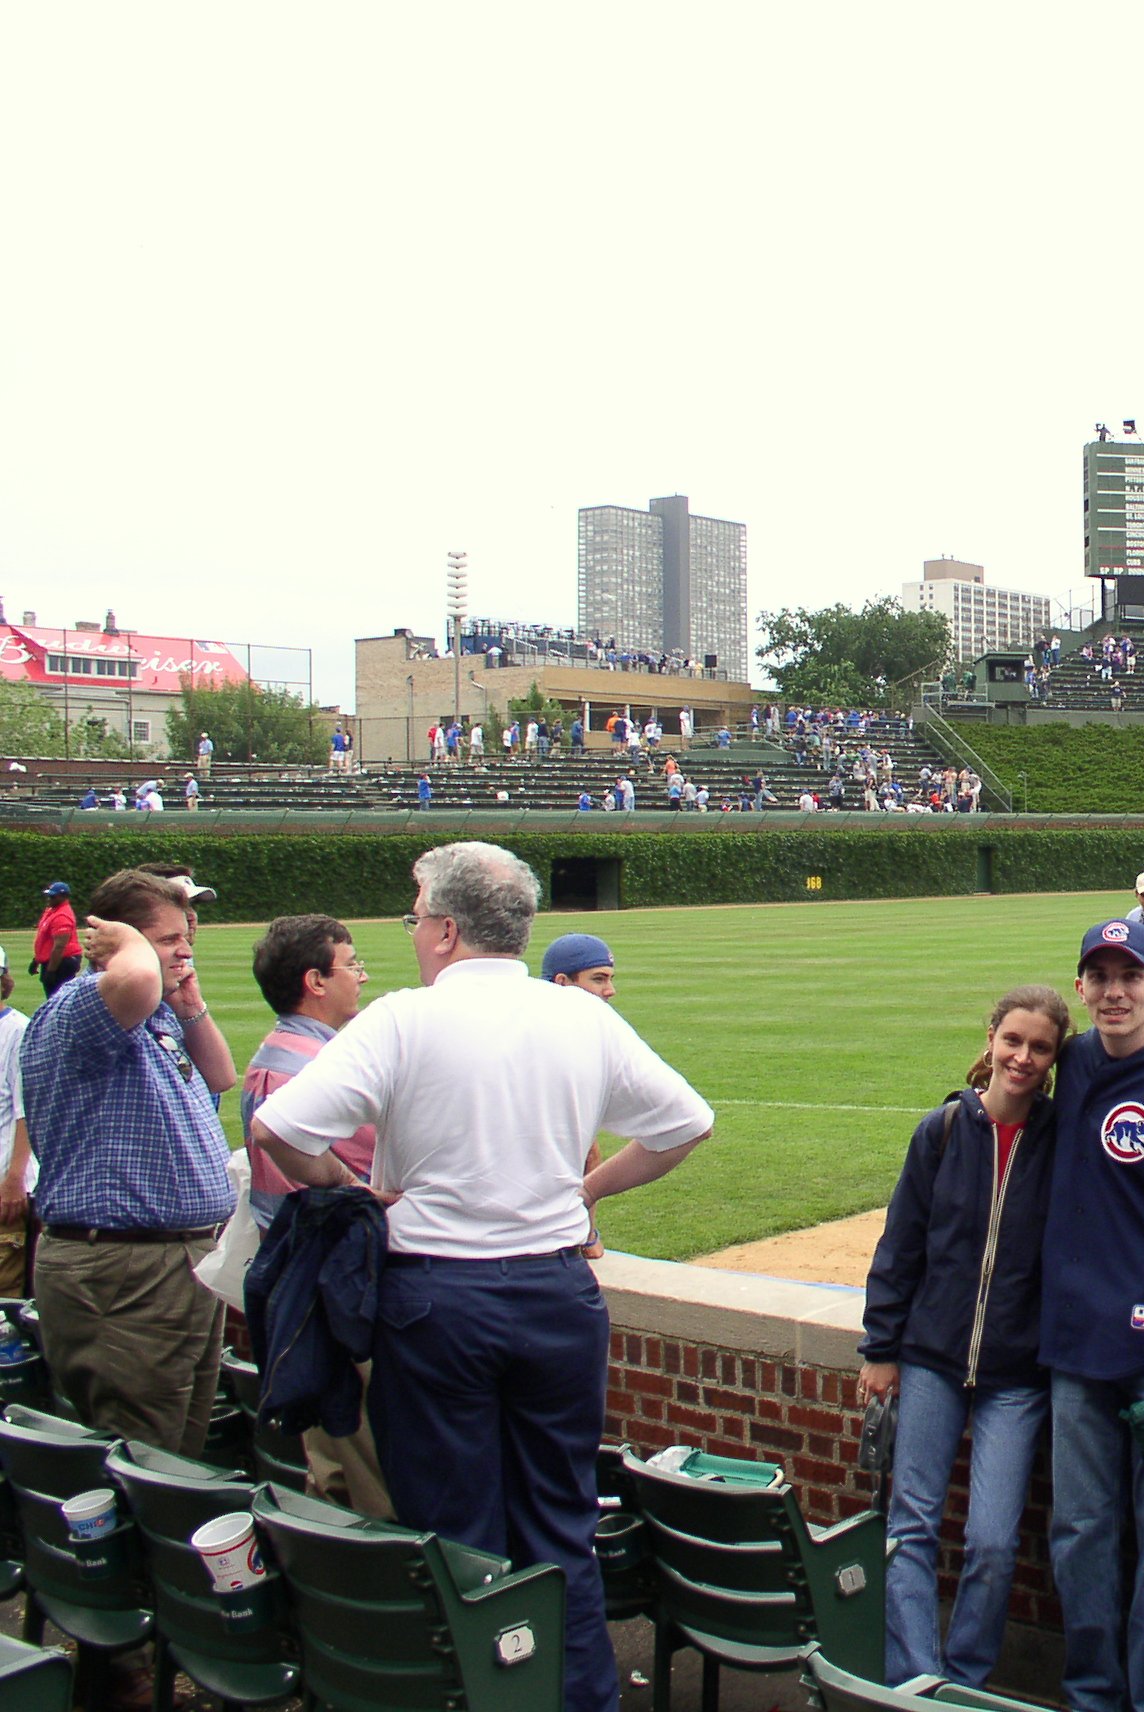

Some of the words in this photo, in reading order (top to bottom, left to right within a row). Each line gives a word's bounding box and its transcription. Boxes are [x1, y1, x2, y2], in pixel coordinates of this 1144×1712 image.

[86, 1556, 107, 1568] Bank
[231, 1607, 253, 1619] Bank
[511, 1634, 522, 1653] 2
